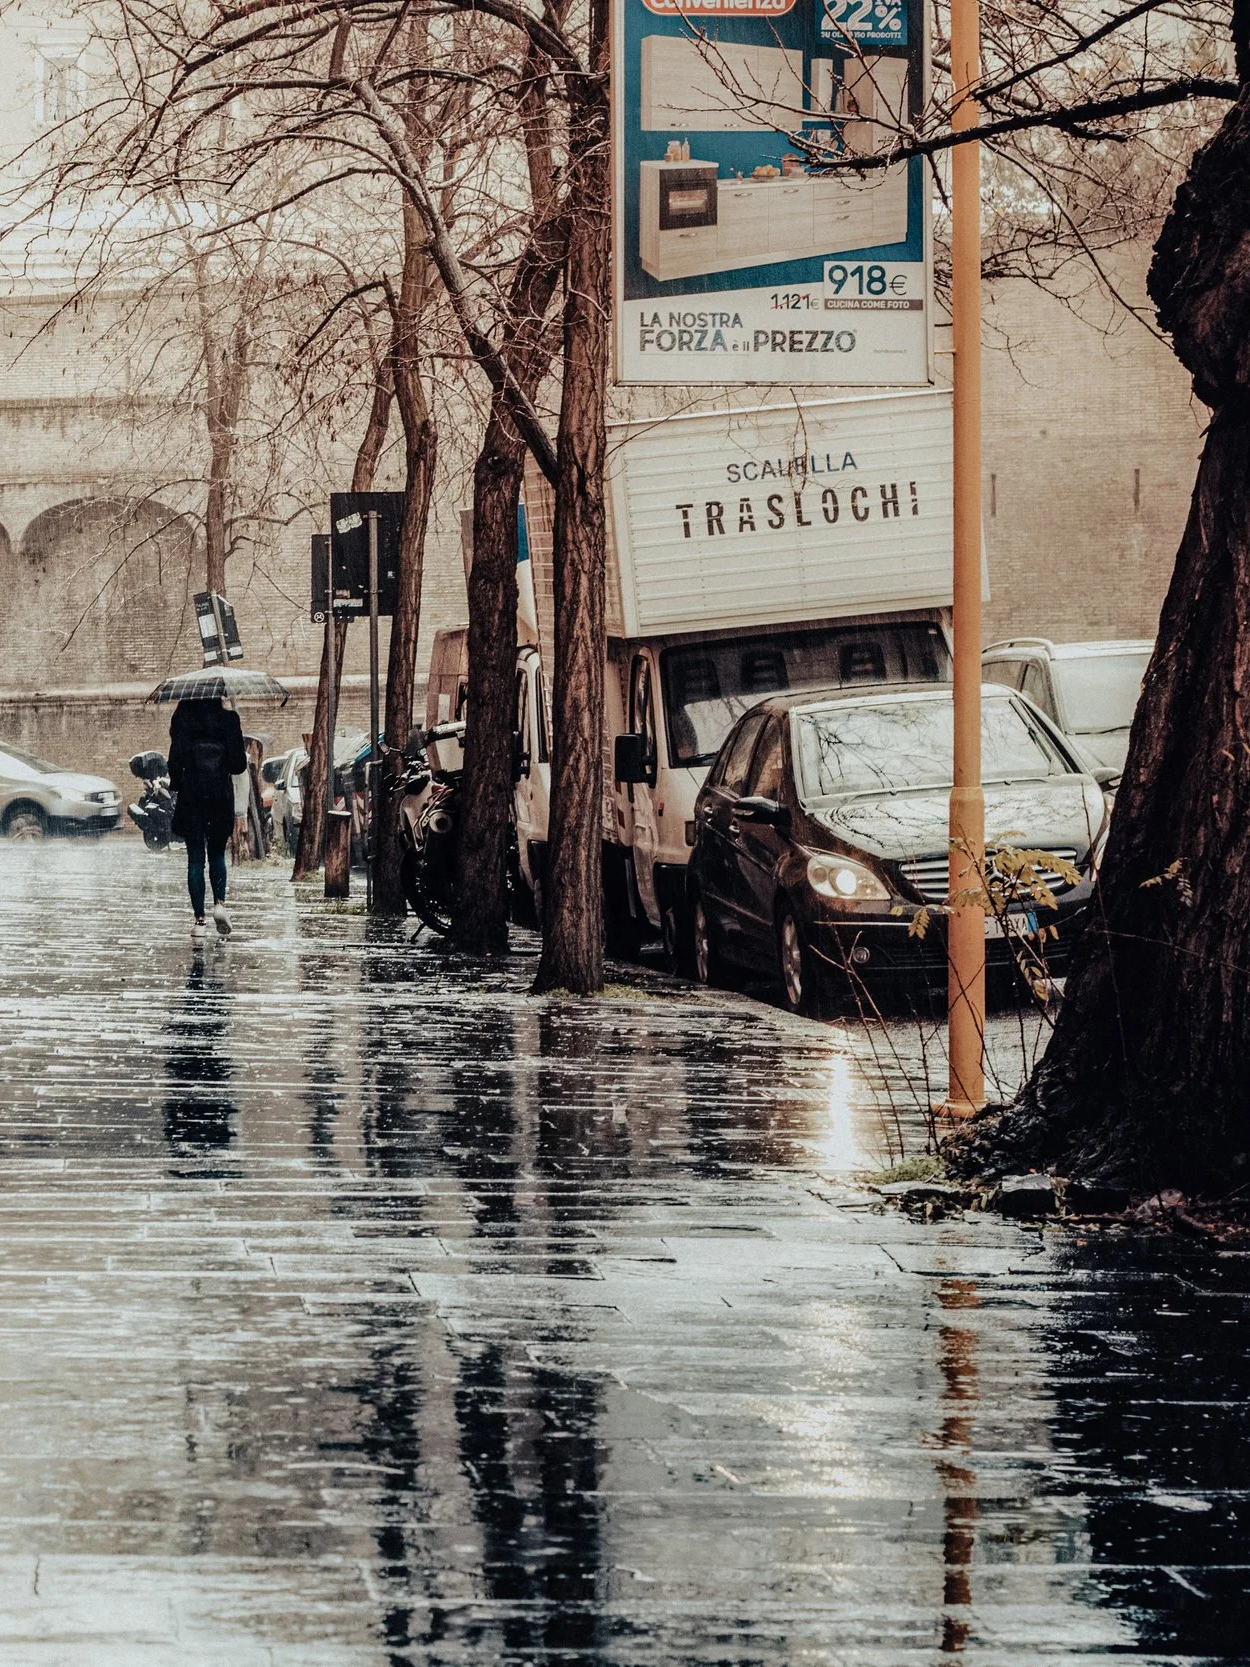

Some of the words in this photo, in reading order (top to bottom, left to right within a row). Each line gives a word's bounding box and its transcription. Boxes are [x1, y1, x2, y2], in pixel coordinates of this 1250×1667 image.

[866, 31, 902, 39] PRODOTTI
[828, 264, 908, 296] 918€
[827, 300, 861, 309] CUCINA
[861, 300, 886, 309] COME
[886, 300, 910, 309] FOTO
[639, 311, 663, 328] LA
[668, 311, 744, 328] NOSTRA
[639, 329, 728, 352] FORZA
[742, 340, 750, 352] il
[753, 329, 856, 353] PREZZO
[675, 480, 919, 539] TRASLOCHI
